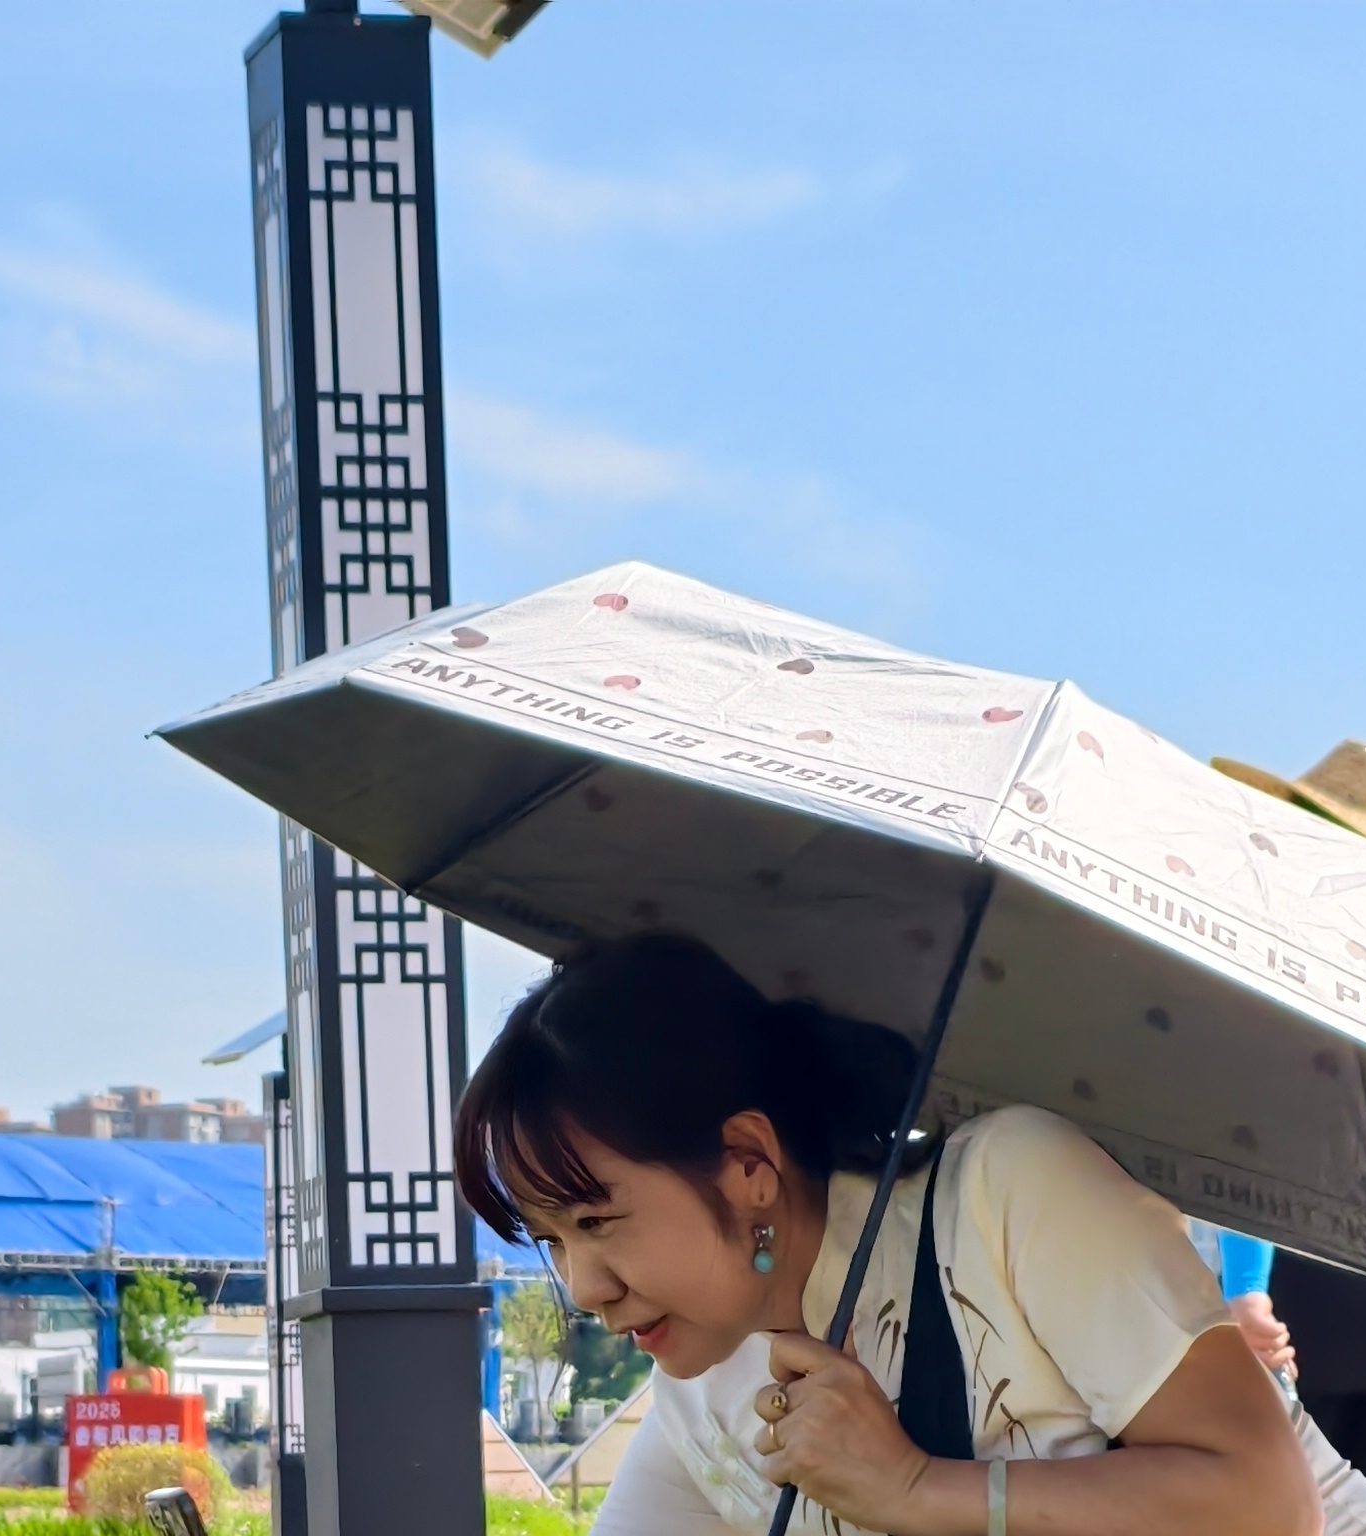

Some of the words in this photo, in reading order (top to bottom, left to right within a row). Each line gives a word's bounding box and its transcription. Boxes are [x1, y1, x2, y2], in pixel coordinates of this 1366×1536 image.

[392, 657, 634, 731] ANYTHING
[649, 731, 705, 749] IS
[722, 750, 967, 819] POSSIBLE
[1010, 828, 1237, 951] ANYTHING
[1268, 947, 1307, 985] IS
